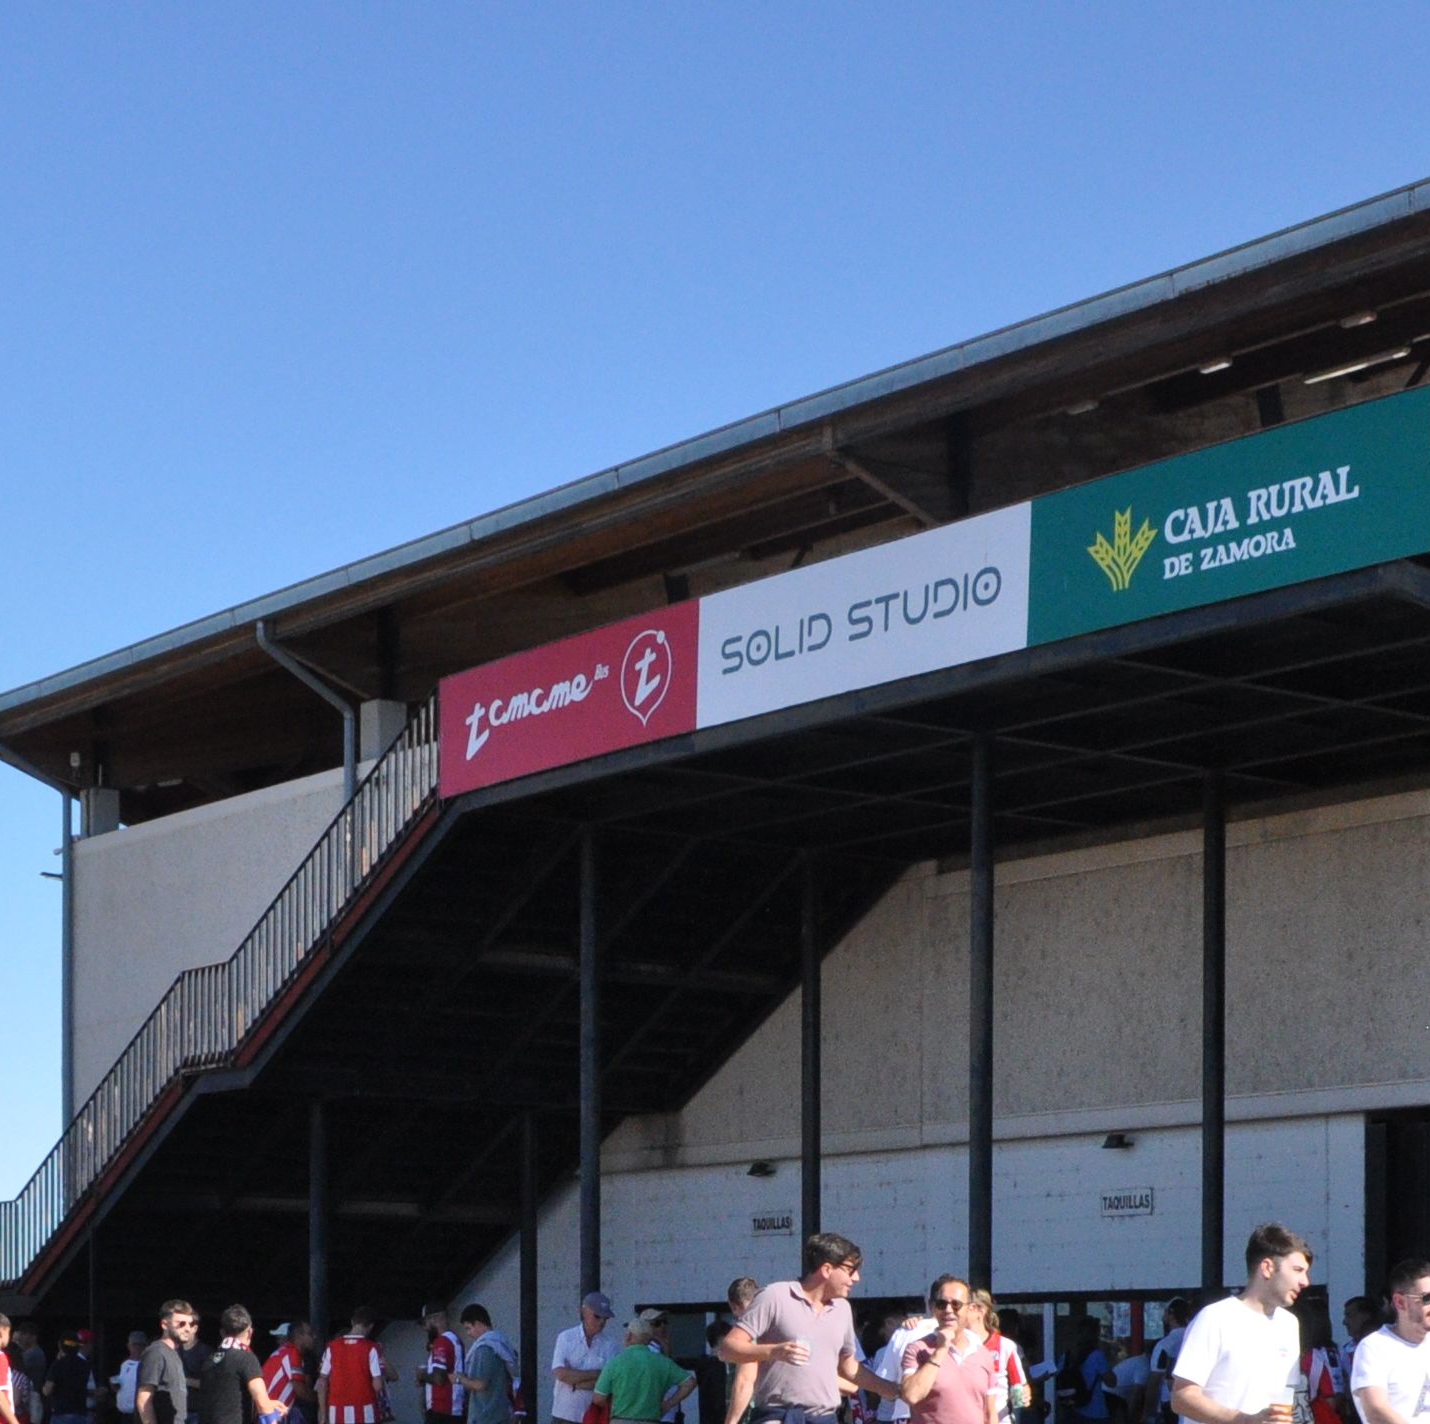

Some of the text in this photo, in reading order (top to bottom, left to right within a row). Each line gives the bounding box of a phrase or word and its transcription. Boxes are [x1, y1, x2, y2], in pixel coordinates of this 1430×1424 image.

[1163, 465, 1361, 545] CAJA RURAL
[1163, 527, 1297, 581] DE ZAMORA
[721, 566, 1002, 676] SOLID STUDIO
[752, 1216, 790, 1231] TAQUILLAS
[1102, 1194, 1150, 1211] TAQUILLAS
